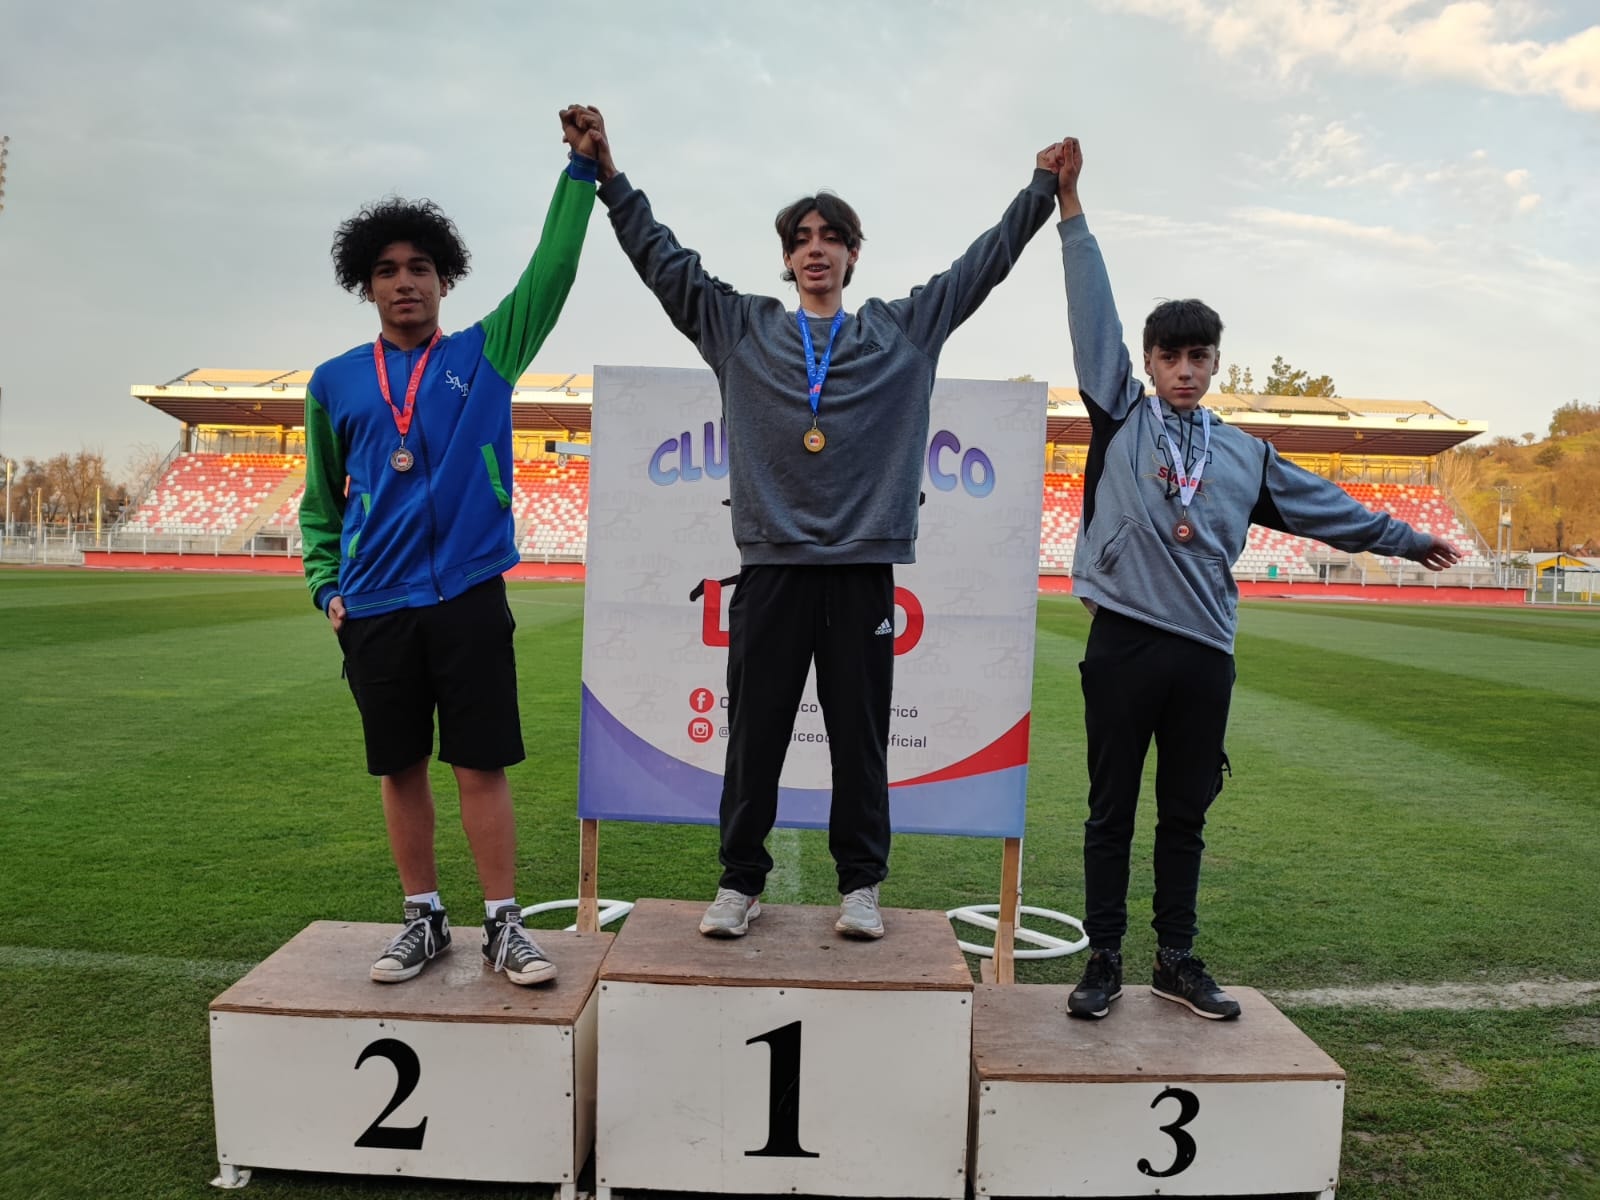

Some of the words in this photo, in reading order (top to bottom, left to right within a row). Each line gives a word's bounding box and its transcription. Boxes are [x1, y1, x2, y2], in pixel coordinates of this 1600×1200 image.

[648, 417, 729, 487] CLU
[929, 429, 996, 499] CO
[889, 733, 927, 748] ficial
[890, 704, 918, 718] ricó
[354, 1037, 428, 1150] 2
[744, 1020, 820, 1158] 1
[1137, 1088, 1200, 1178] 3
